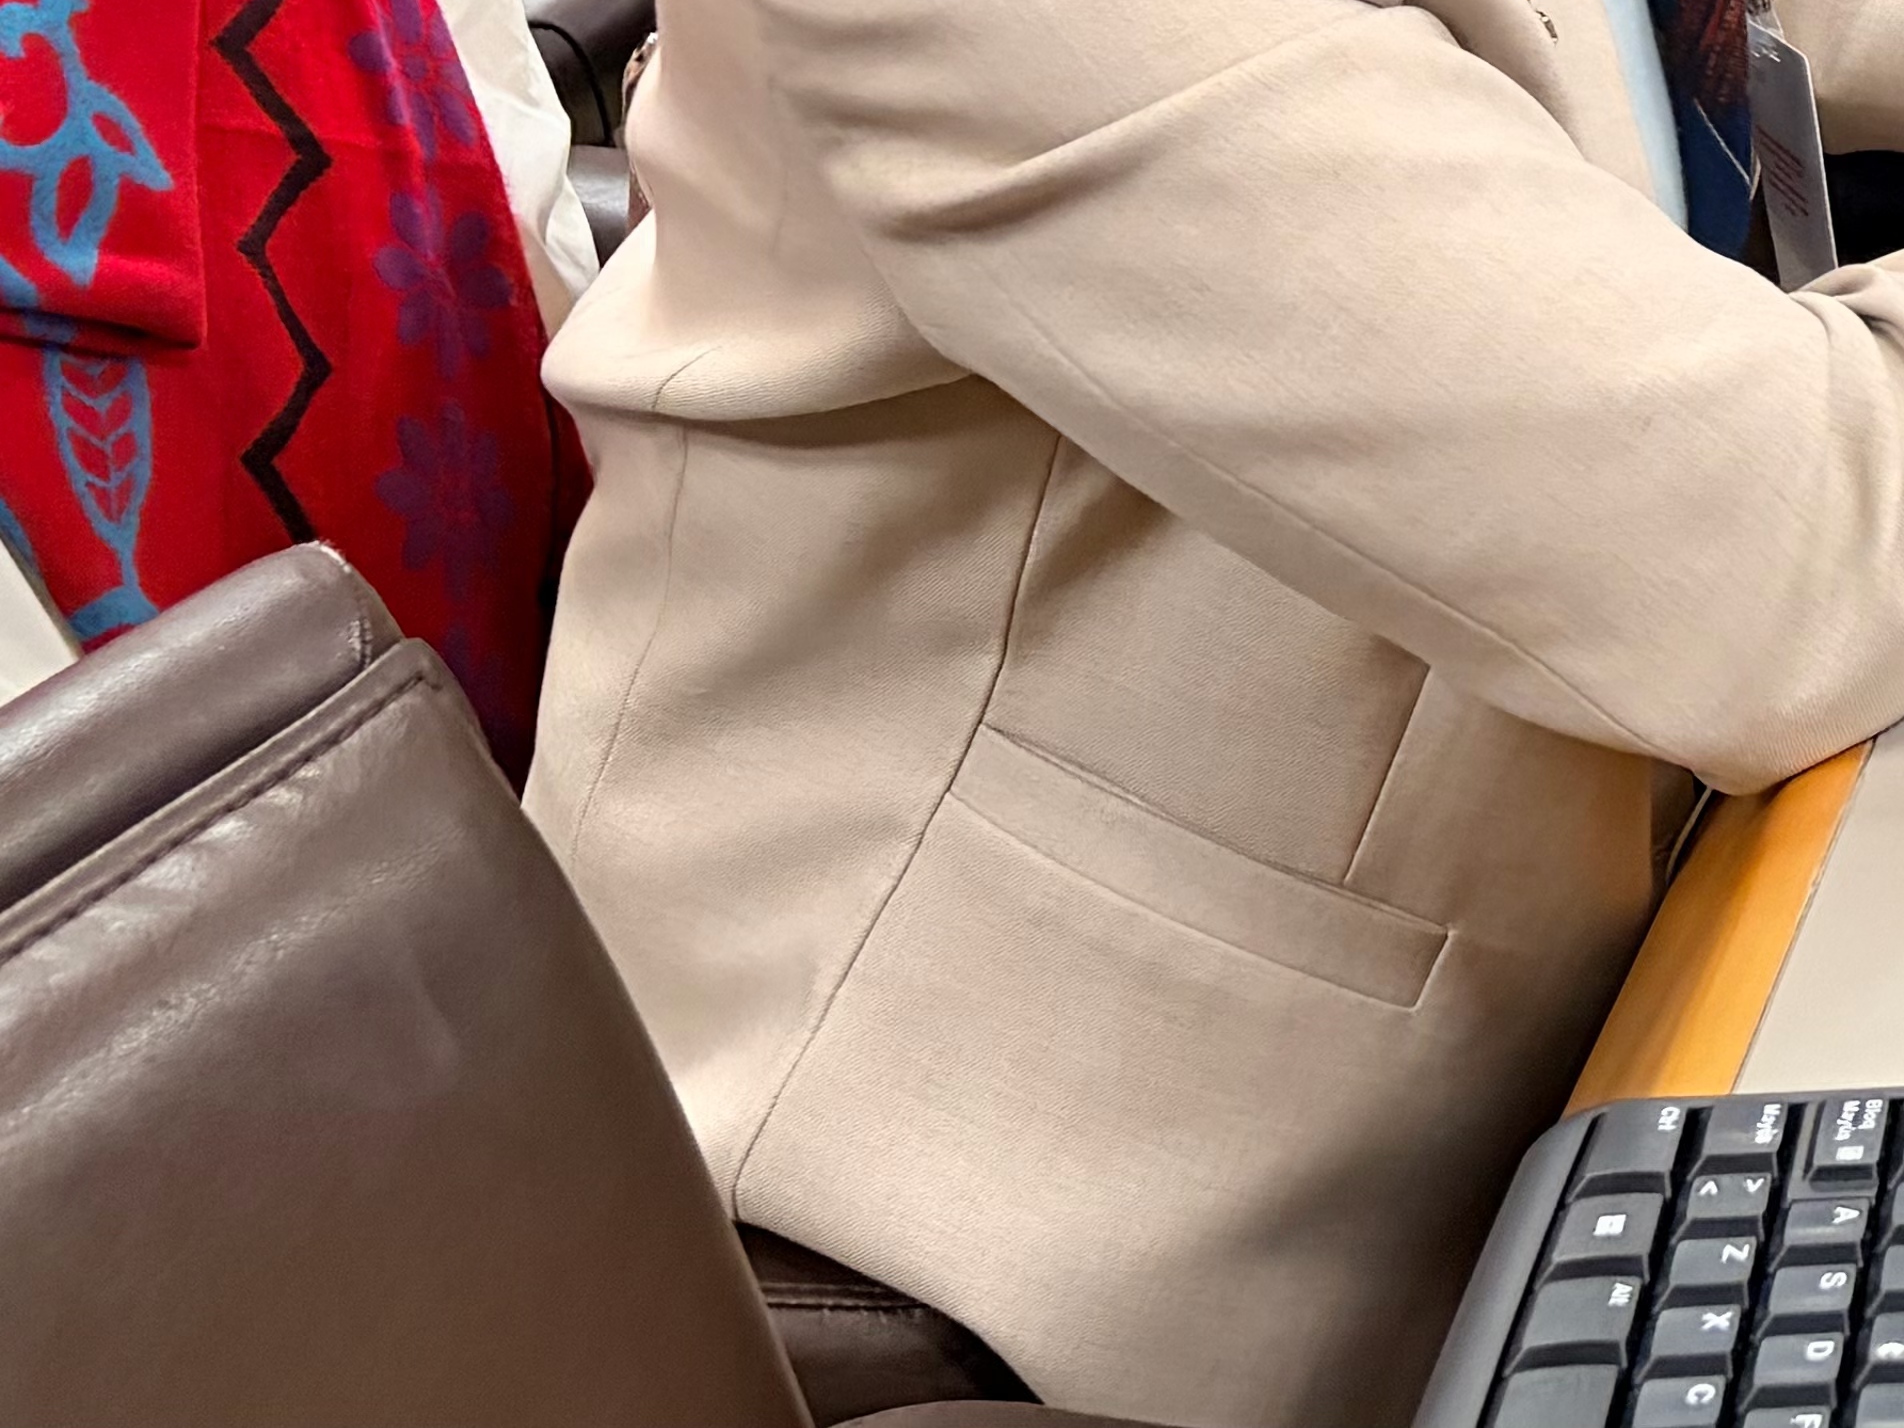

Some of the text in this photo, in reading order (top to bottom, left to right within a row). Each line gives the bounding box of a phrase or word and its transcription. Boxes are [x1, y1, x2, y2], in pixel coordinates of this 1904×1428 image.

[1657, 1105, 1680, 1131] Ctrl
[1857, 1099, 1883, 1131] Bloq
[1831, 1206, 1861, 1225] A
[1721, 1243, 1750, 1264] Z
[1819, 1270, 1848, 1290] S
[1607, 1282, 1633, 1307] Alt
[1701, 1310, 1733, 1331] X
[1805, 1340, 1836, 1362] D
[1685, 1382, 1716, 1406] C
